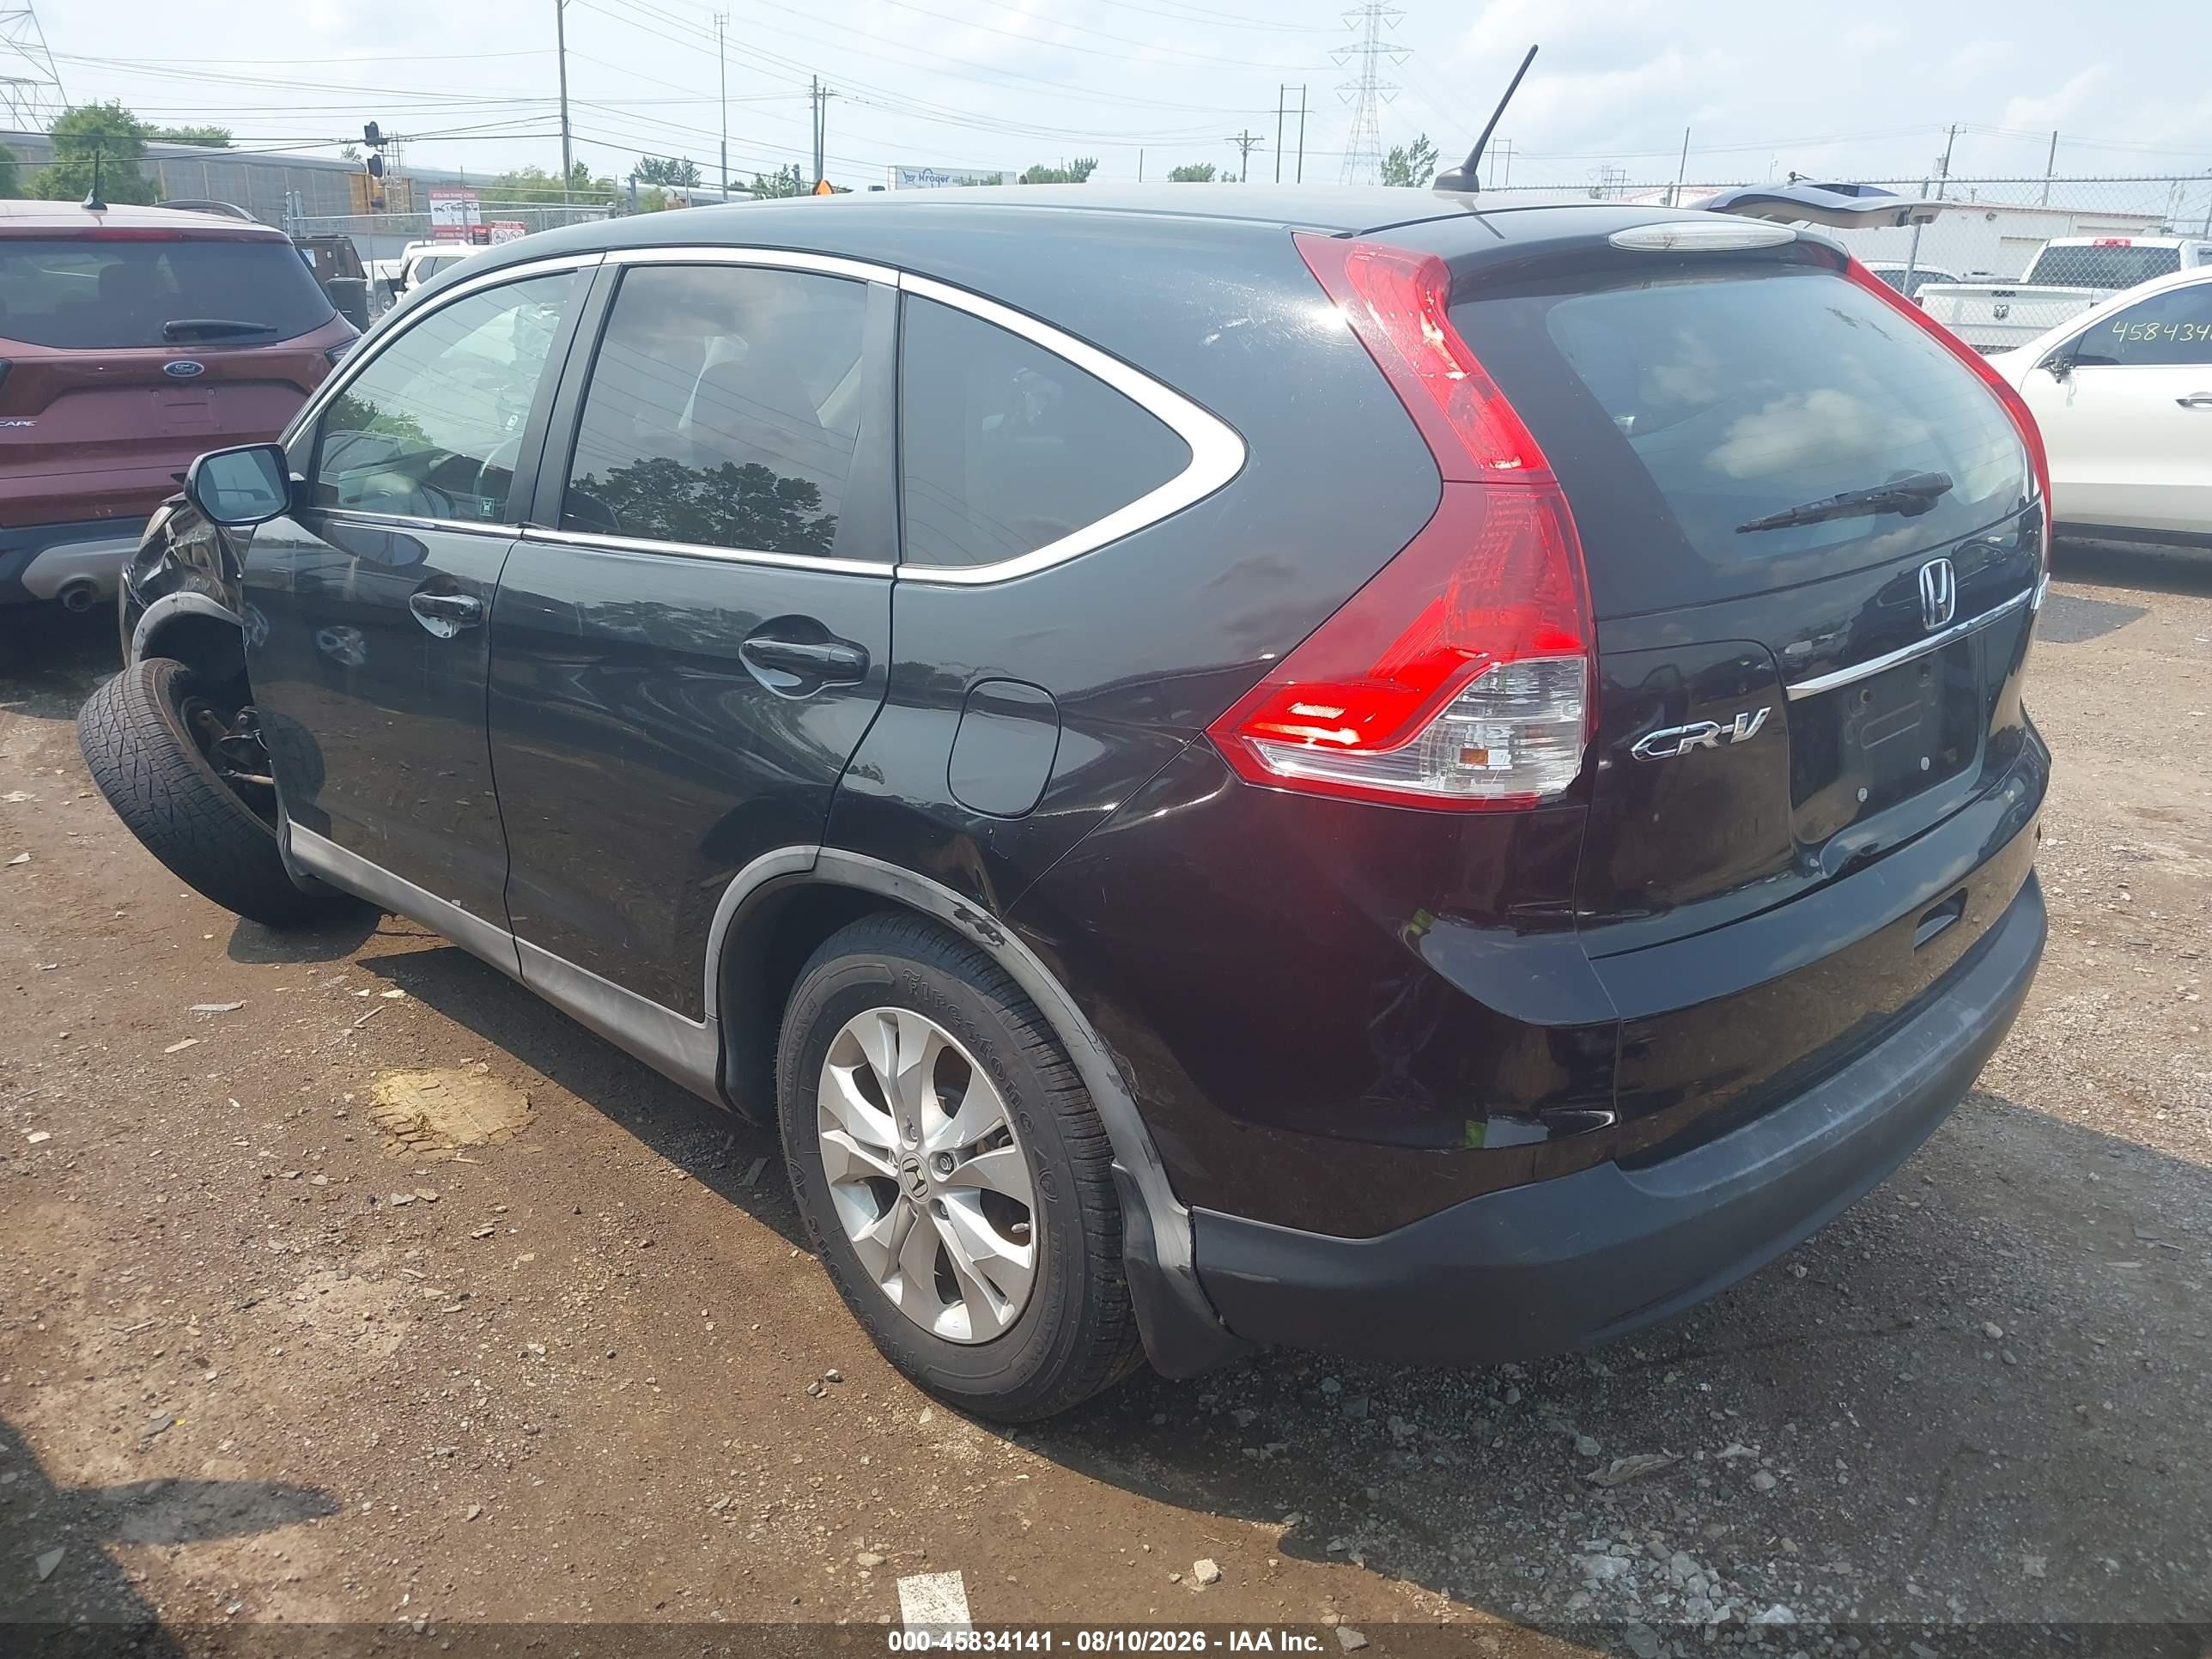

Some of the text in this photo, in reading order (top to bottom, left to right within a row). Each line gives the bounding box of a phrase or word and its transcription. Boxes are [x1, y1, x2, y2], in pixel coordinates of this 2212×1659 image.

[2112, 321, 2212, 342] 458434
[1631, 707, 1771, 762] CR-V
[902, 968, 1036, 1135] Firestone
